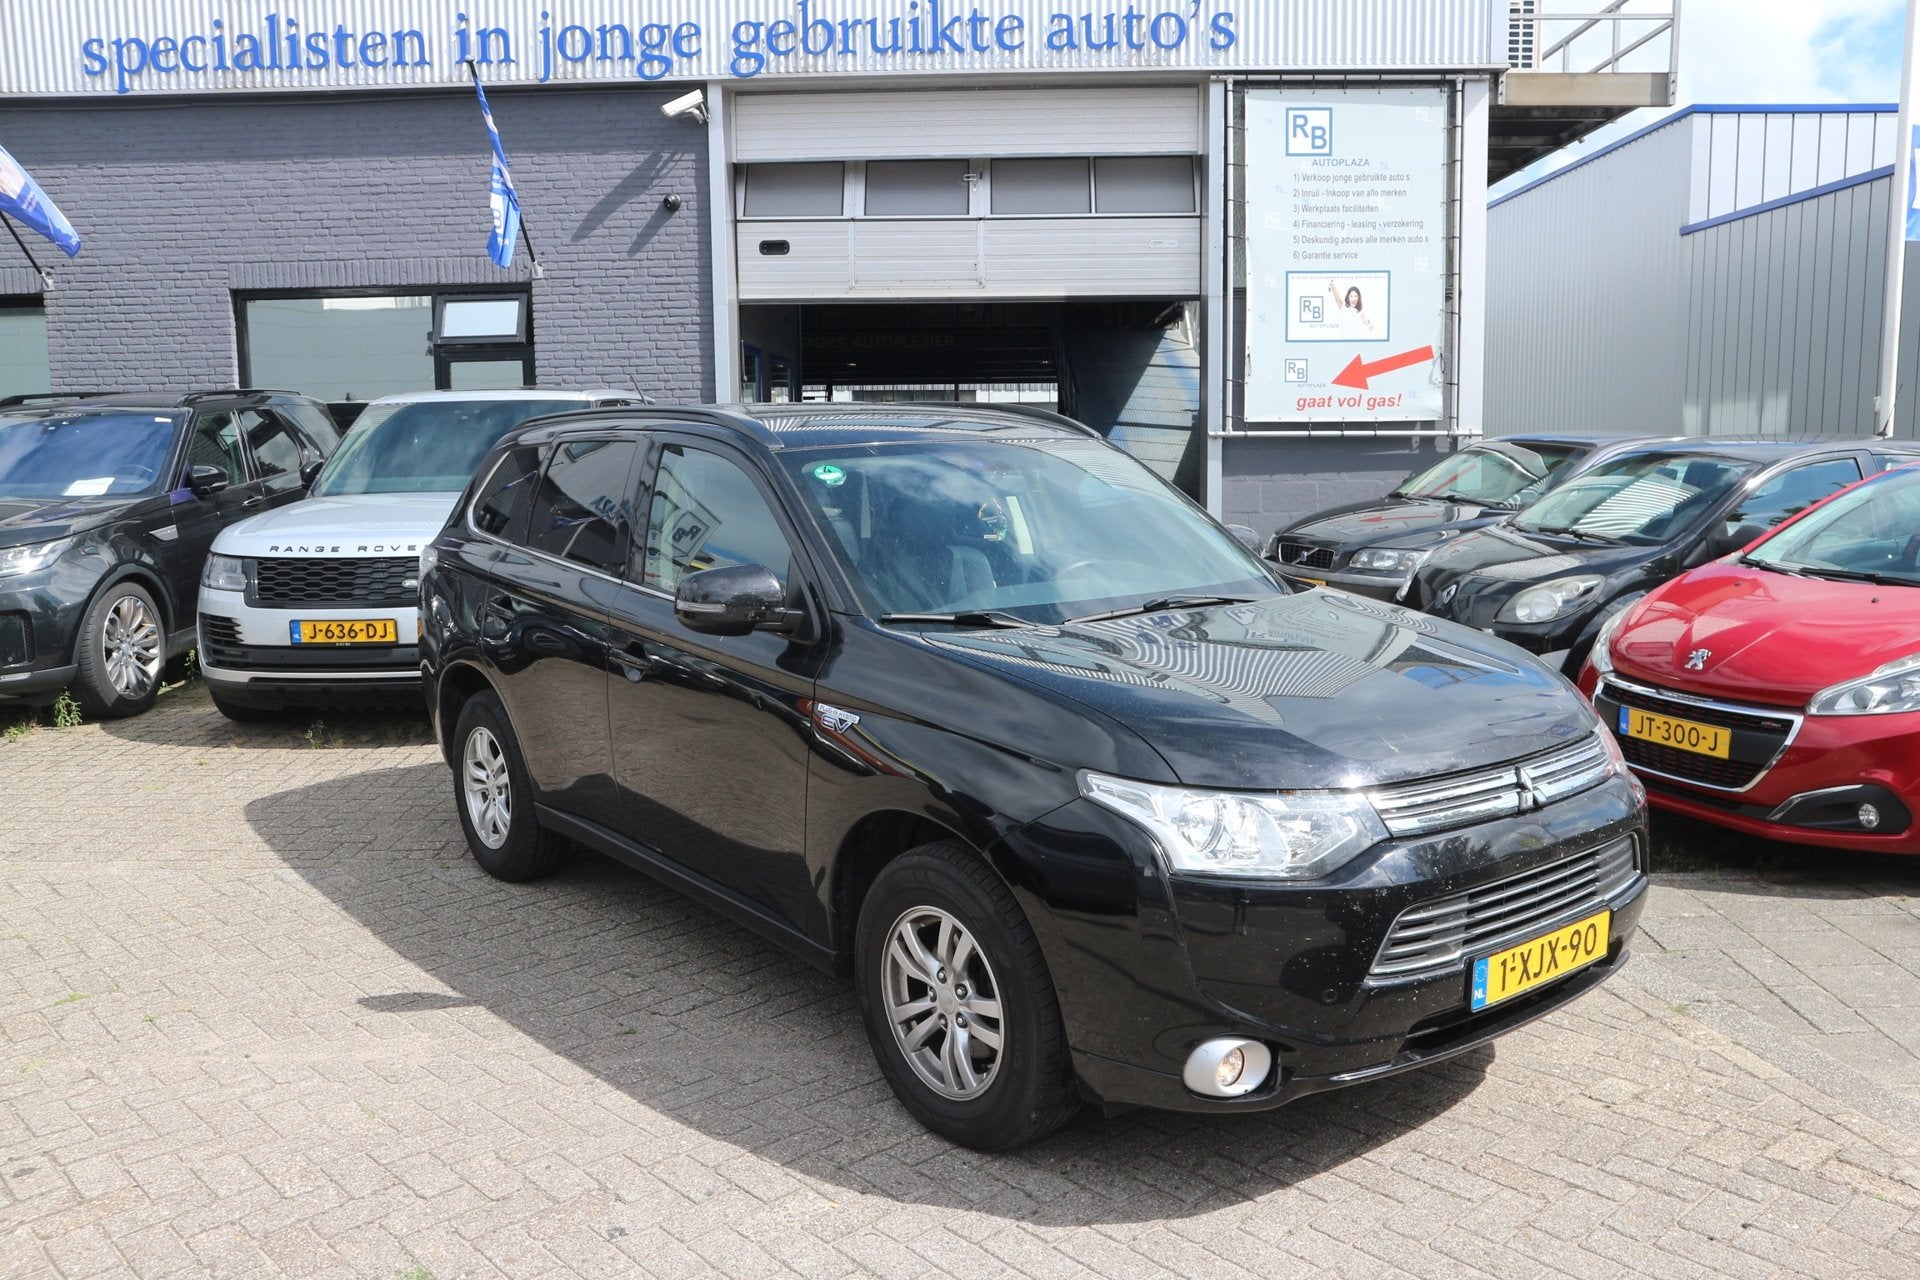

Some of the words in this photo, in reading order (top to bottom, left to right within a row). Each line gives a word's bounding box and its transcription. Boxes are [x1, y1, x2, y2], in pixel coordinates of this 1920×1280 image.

[81, 13, 431, 95] specialisten
[455, 12, 514, 65] in
[538, 10, 703, 83] jonge
[729, 0, 1025, 78] gebruikte
[1046, 0, 1237, 51] auto's
[1292, 114, 1328, 149] RB
[1311, 158, 1370, 167] AUTOPLAZA
[1293, 173, 1300, 183] 1)
[1302, 173, 1331, 183] Verkoop
[1332, 173, 1352, 183] jonge
[1354, 173, 1387, 183] gebruikte
[1293, 189, 1300, 198] 2)
[1302, 189, 1319, 197] Inruil
[1326, 189, 1350, 198] Inkoop
[1366, 188, 1379, 197] alle
[1380, 188, 1407, 197] merken
[1293, 204, 1300, 214] 3)
[1302, 204, 1340, 214] Werkplaats
[1342, 204, 1379, 213] faciliteiten
[1293, 220, 1300, 230] 4)
[1302, 220, 1345, 230] Financiering
[1351, 220, 1377, 230] leasing
[1383, 219, 1424, 229] verzekering
[1293, 235, 1300, 246] 5)
[1302, 235, 1339, 246] Deskundig
[1341, 235, 1364, 243] advies
[1365, 235, 1378, 243] alle
[1379, 235, 1405, 243] merken
[1293, 251, 1300, 261] 6)
[1302, 251, 1331, 260] Garantie
[1333, 251, 1359, 260] service
[1296, 395, 1333, 411] gaat
[1337, 394, 1363, 407] vol
[1366, 393, 1402, 411] gas!
[269, 545, 341, 553] RANGE
[357, 544, 417, 553] ROVE
[309, 622, 388, 640] J-636-DJ
[821, 713, 852, 734] EV
[1620, 722, 1628, 730] NL
[1636, 715, 1718, 752] JT-300-J
[1474, 988, 1485, 1001] NL
